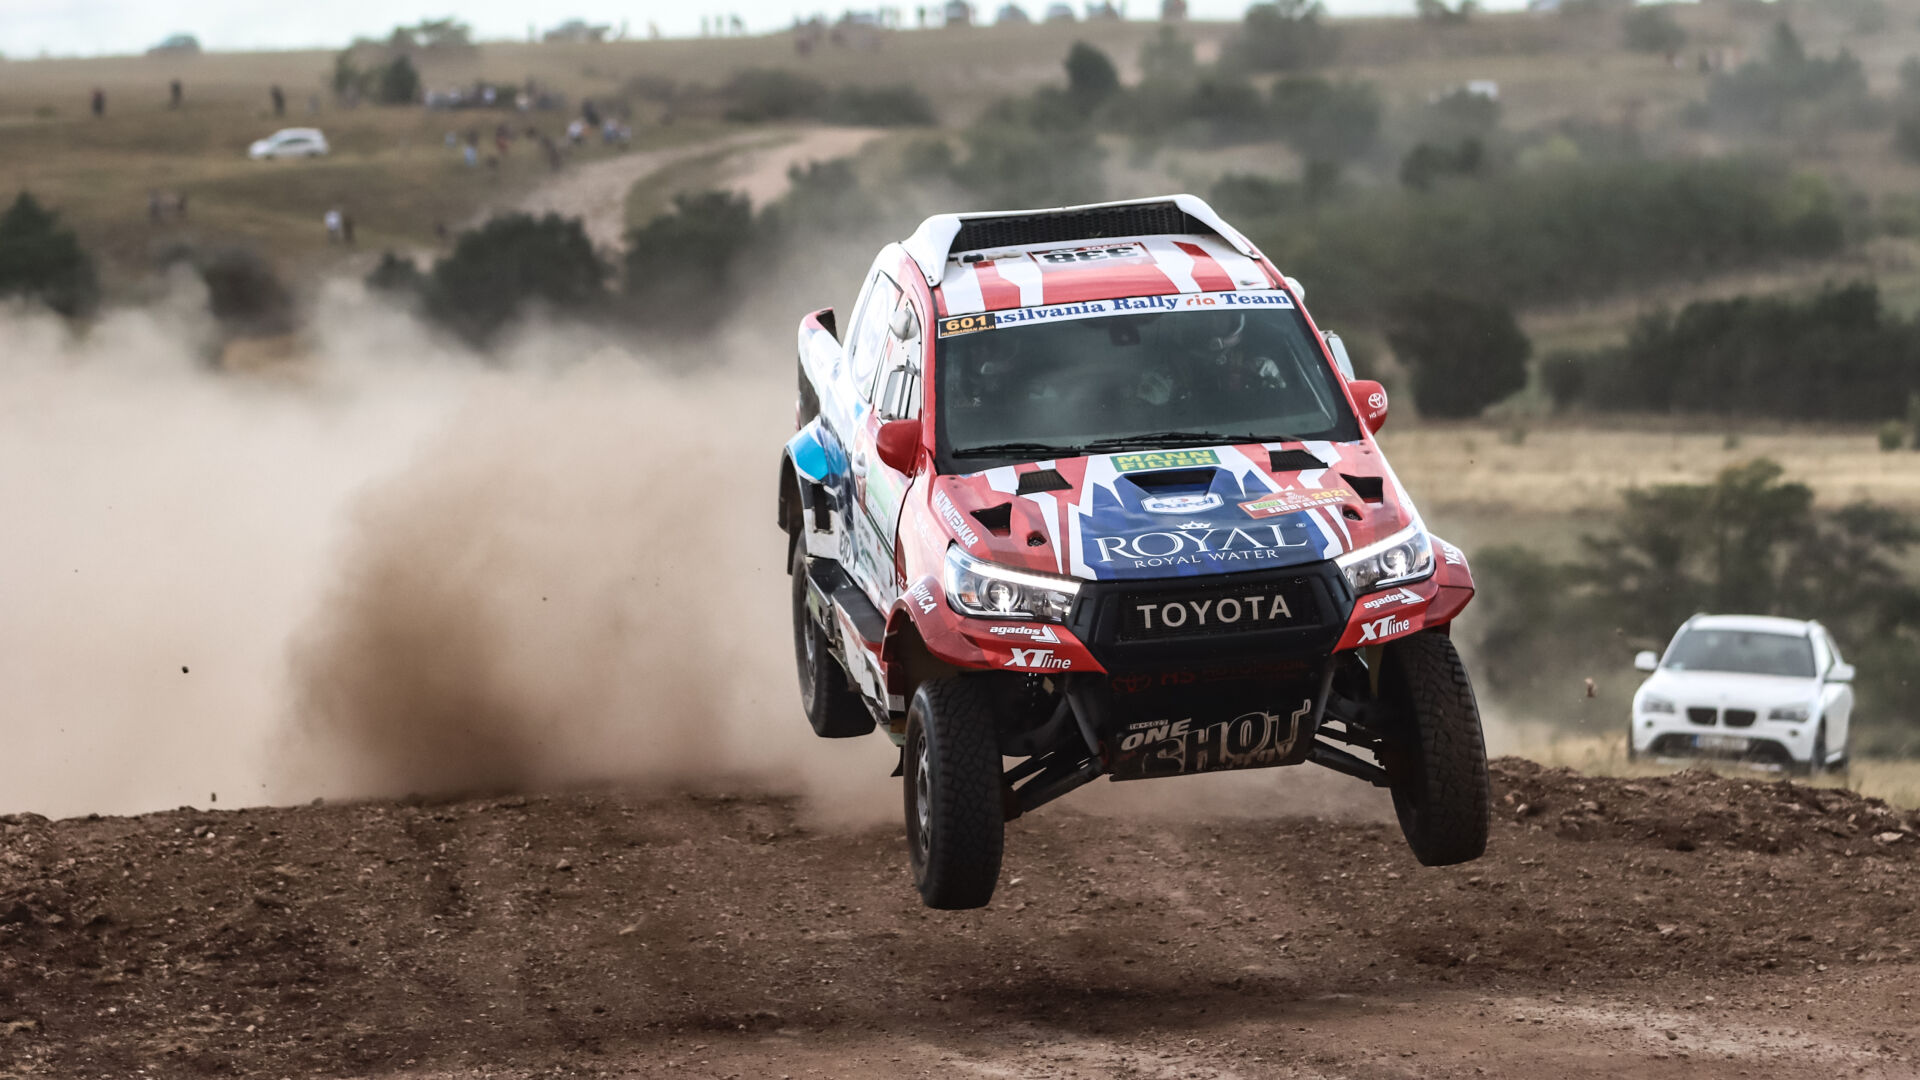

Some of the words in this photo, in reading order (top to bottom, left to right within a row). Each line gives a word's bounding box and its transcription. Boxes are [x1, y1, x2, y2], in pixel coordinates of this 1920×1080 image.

[1112, 295, 1178, 310] Rally
[1186, 294, 1216, 306] ria
[1220, 293, 1290, 305] Team
[945, 315, 987, 331] 601
[1116, 450, 1211, 463] MANN
[1120, 457, 1216, 471] FILTER
[1311, 489, 1353, 500] 2021
[1267, 502, 1302, 514] SAUDI
[1303, 496, 1344, 509] ARABIA
[1094, 524, 1308, 563] ROYAL
[1134, 554, 1202, 569] ROYAL
[1208, 549, 1279, 561] WATER
[1363, 593, 1406, 609] agados
[1136, 595, 1292, 629] TOYOTA
[989, 625, 1041, 636] agados
[1357, 614, 1410, 644] XTline
[1004, 648, 1072, 669] XTline
[1121, 718, 1192, 750] ONE
